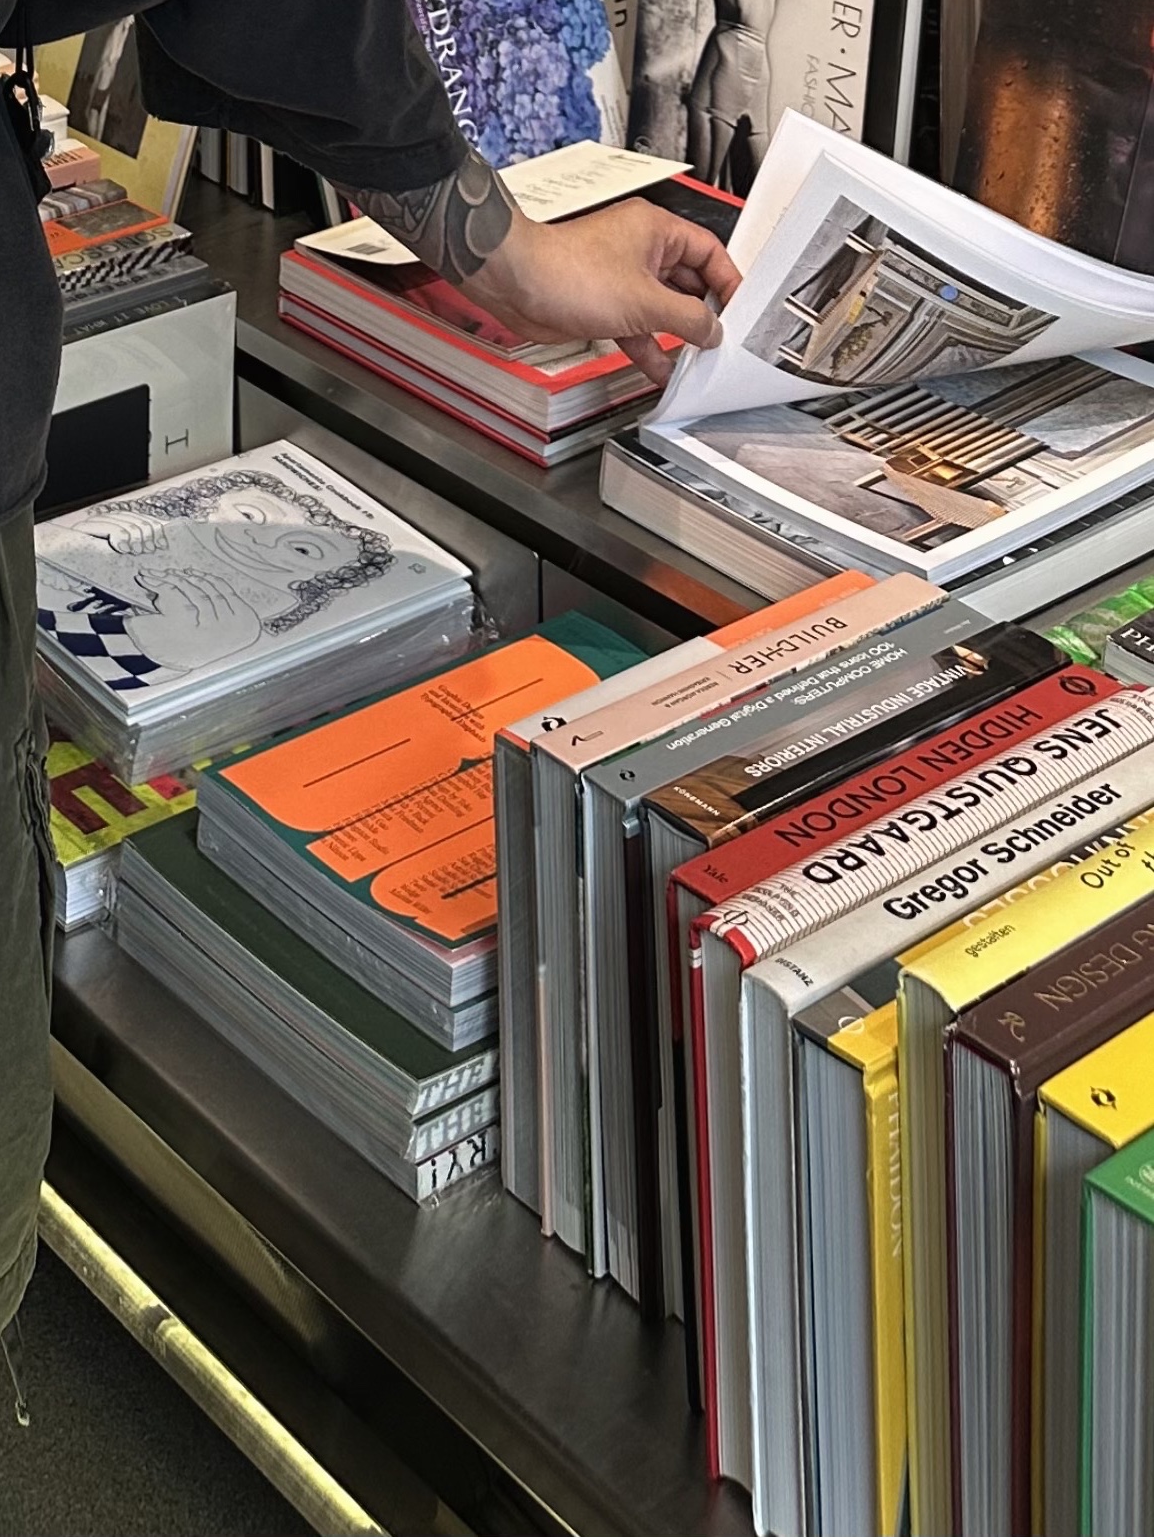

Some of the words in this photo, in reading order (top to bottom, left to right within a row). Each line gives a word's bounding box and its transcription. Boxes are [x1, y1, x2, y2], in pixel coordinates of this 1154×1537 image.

[800, 52, 820, 119] FASHIO
[837, 650, 870, 669] Icons
[867, 639, 894, 656] 100
[868, 647, 907, 669] HOME
[1119, 624, 1154, 653] PH
[772, 674, 817, 700] Defined
[789, 662, 873, 707] COMPUTERS:
[814, 664, 840, 680] that
[905, 663, 969, 699] VINTAGE
[728, 697, 766, 723] Digital
[822, 690, 912, 740] INDUSTRIAL
[665, 716, 731, 753] Generation
[743, 731, 828, 778] INTERIORS
[916, 704, 1042, 771] HIDDEN
[1034, 706, 1122, 763] JENS
[772, 764, 924, 846] LONDON
[799, 752, 1038, 890] QUISTGAARD
[881, 853, 988, 924] Gregor
[979, 777, 1122, 867] Schneider
[1080, 864, 1122, 889] Out
[1117, 840, 1136, 858] of
[964, 923, 1016, 958] gestalten
[1031, 940, 1141, 1012] DESIGN
[430, 1129, 497, 1189] RY!
